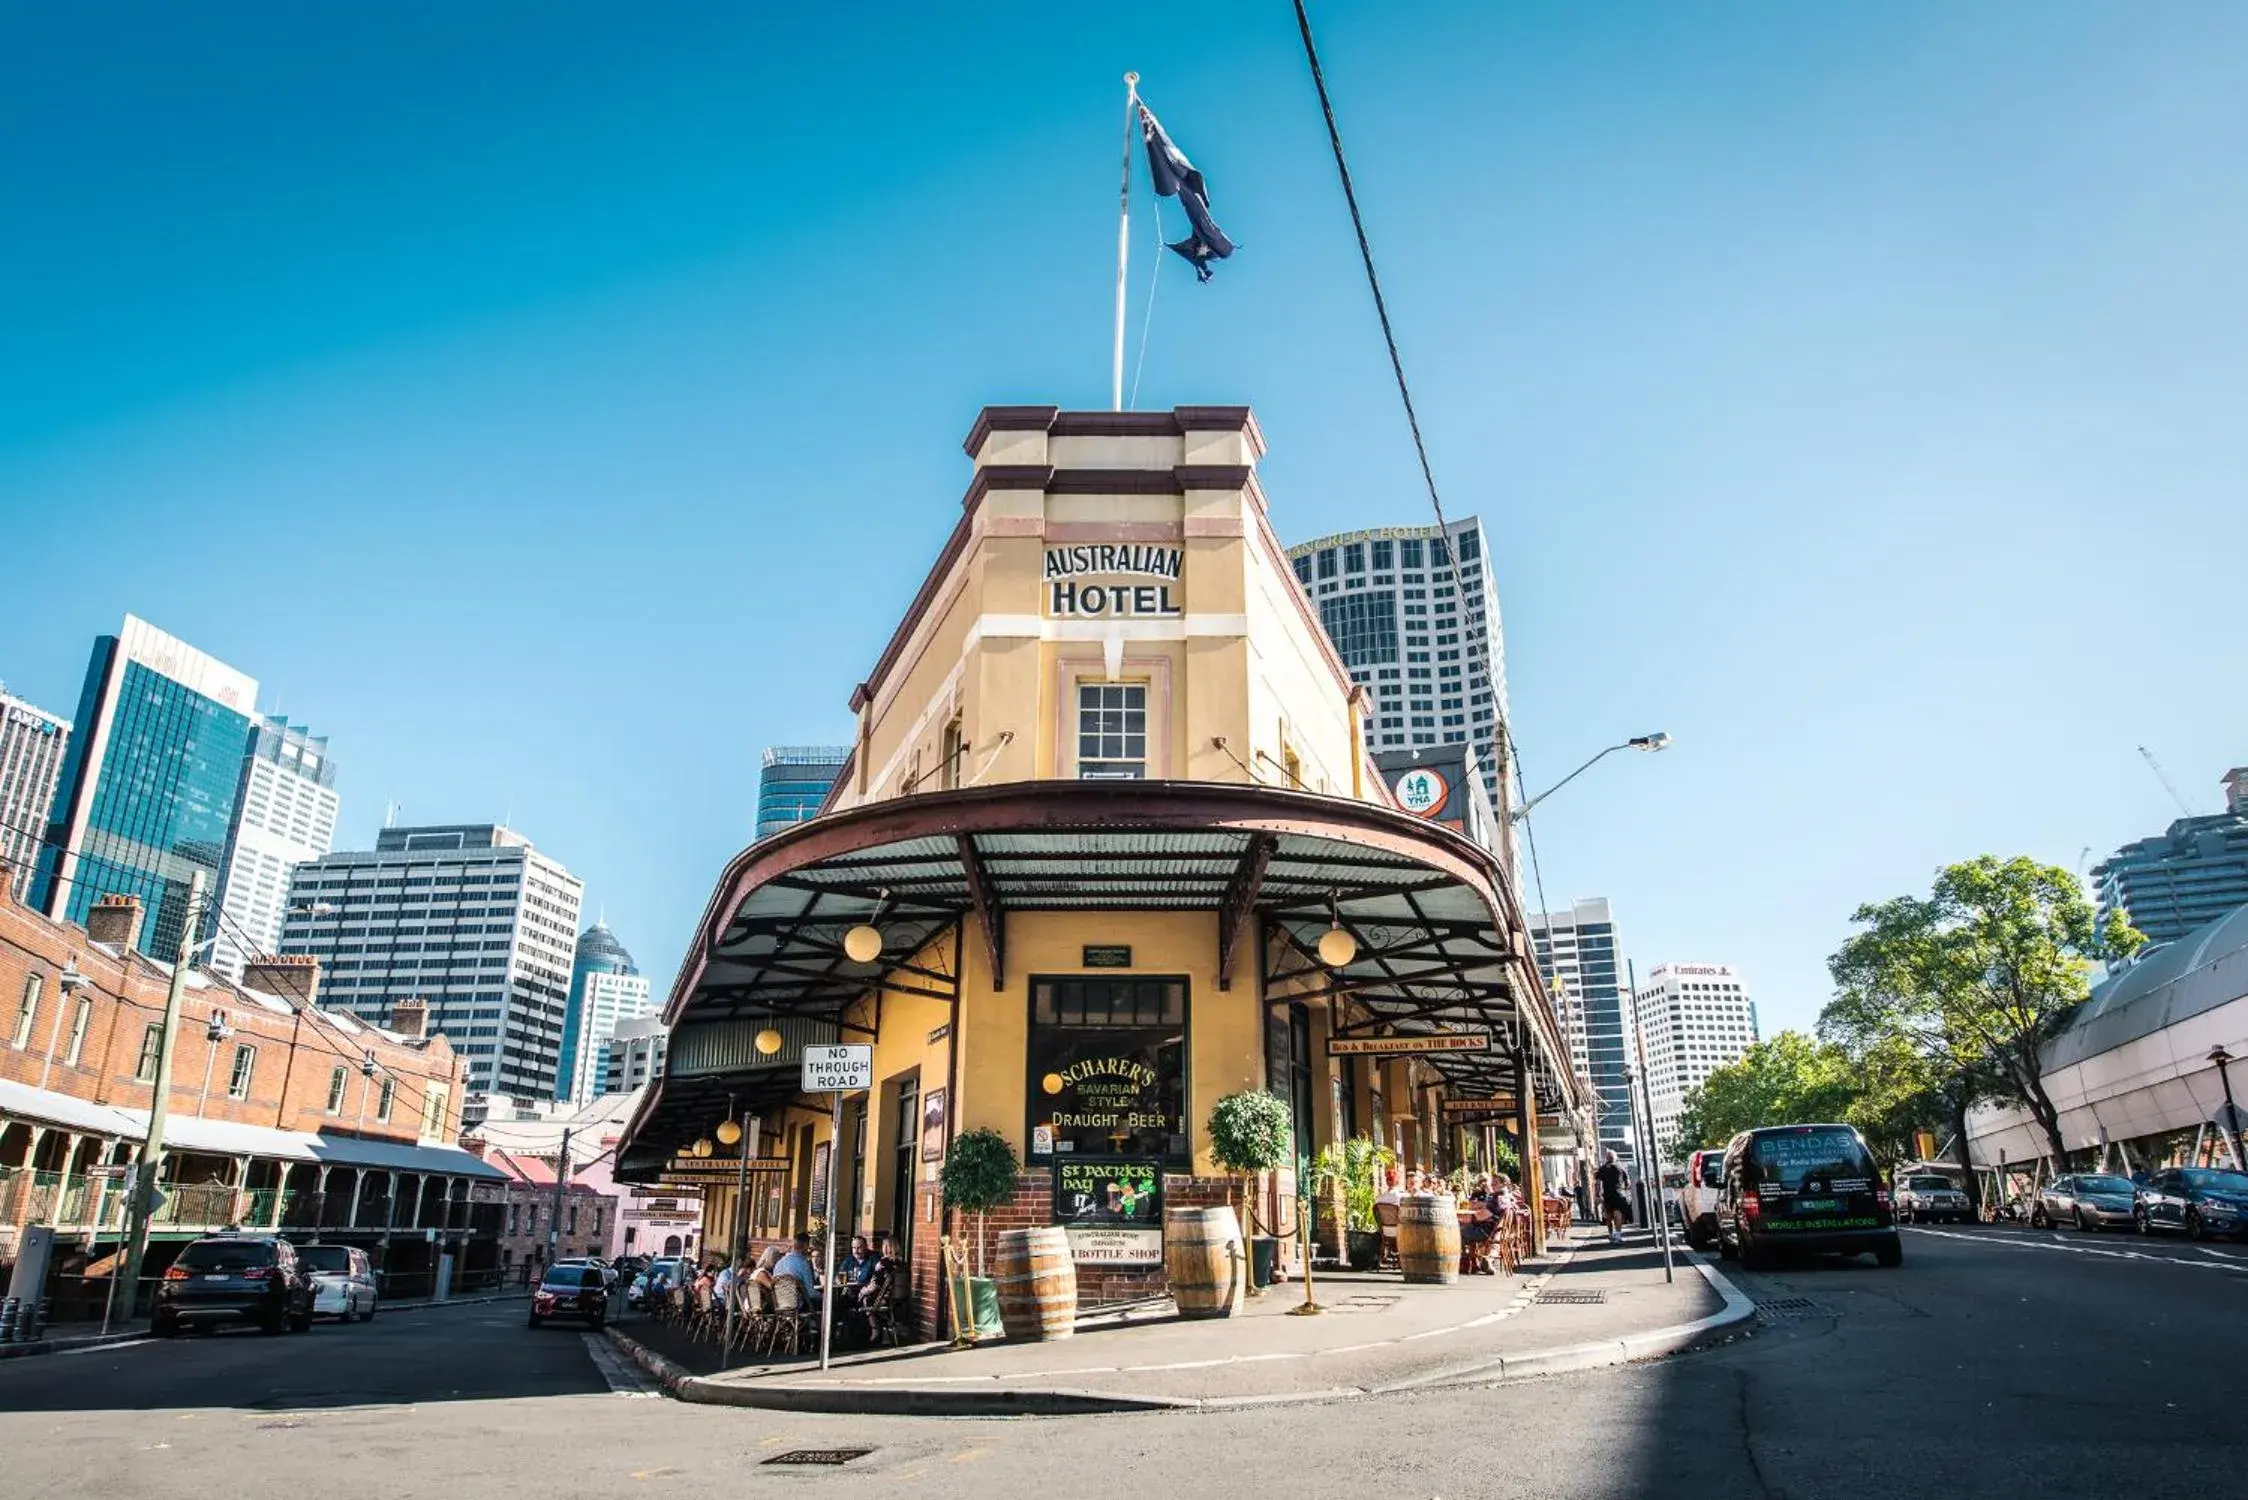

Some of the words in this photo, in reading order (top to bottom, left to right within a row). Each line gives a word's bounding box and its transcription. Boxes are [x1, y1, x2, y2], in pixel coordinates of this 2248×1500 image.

[1045, 545, 1184, 578] AUSTRALIAN
[1053, 582, 1181, 613] HOTEL
[1408, 795, 1430, 804] YHA
[1674, 965, 1717, 975] Emirates
[1427, 1039, 1446, 1048] THE
[828, 1048, 848, 1059] NO
[808, 1061, 869, 1074] THROUGH
[1060, 1057, 1156, 1087] SCHARER'S
[817, 1075, 859, 1087] ROAD
[1077, 1084, 1140, 1096] BAVARIAN
[1088, 1096, 1129, 1107] STYLE
[1052, 1111, 1119, 1127] DRAUGHT
[1128, 1112, 1166, 1128] BEER
[1762, 1136, 1851, 1152] BENDAS
[1767, 1220, 1801, 1230] MOBILE
[1079, 1249, 1123, 1259] BOTTLE
[1128, 1249, 1160, 1259] SHOP
